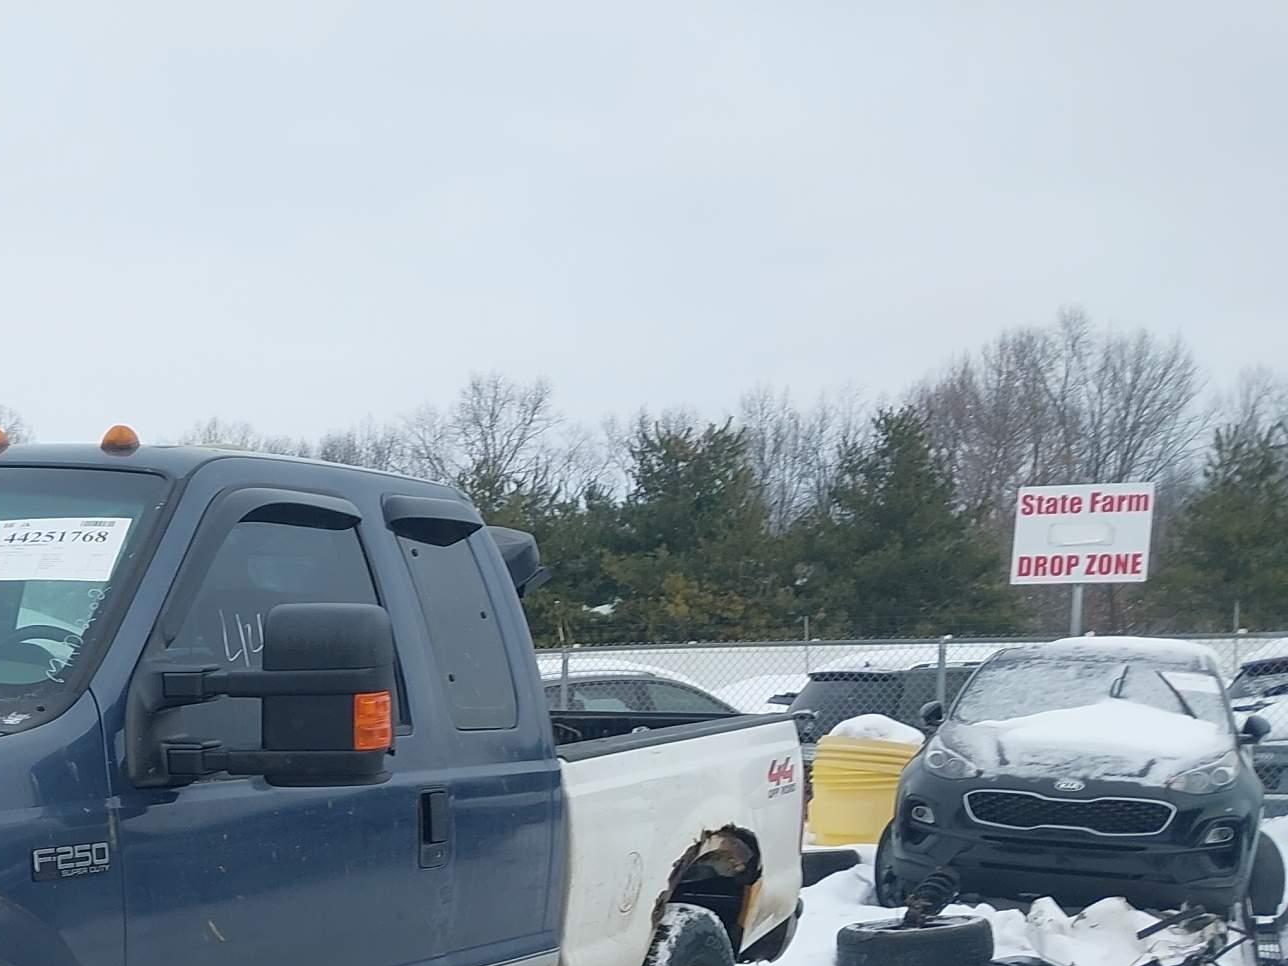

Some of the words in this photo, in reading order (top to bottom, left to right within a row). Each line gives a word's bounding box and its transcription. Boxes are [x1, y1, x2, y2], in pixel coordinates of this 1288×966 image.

[1021, 494, 1083, 516] State
[1089, 491, 1150, 513] Farm
[3, 530, 110, 544] 44251768
[1016, 555, 1081, 577] DROP
[1084, 553, 1143, 576] ZONE
